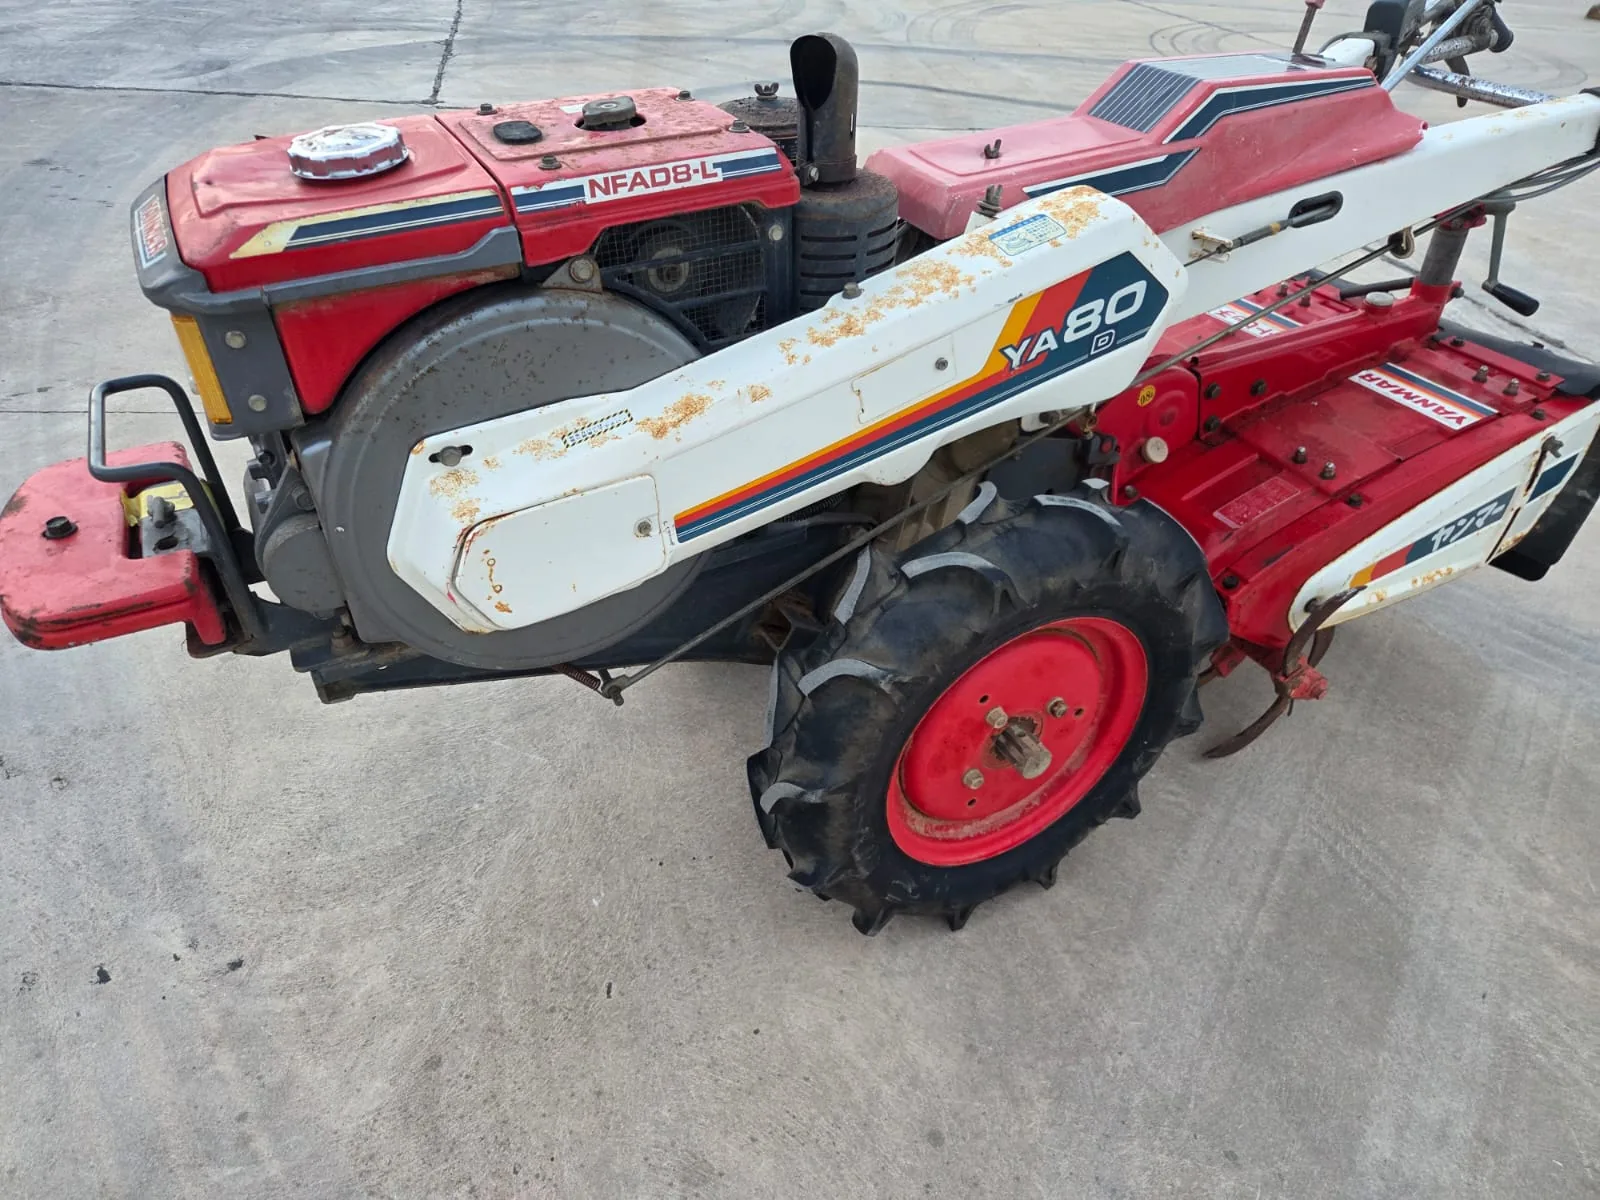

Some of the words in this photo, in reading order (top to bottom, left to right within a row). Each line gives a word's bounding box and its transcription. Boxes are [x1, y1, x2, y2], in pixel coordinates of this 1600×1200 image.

[588, 161, 717, 198] NFAD8-L
[1359, 373, 1467, 425] YANMAR
[1431, 501, 1505, 553] ヤンマー
